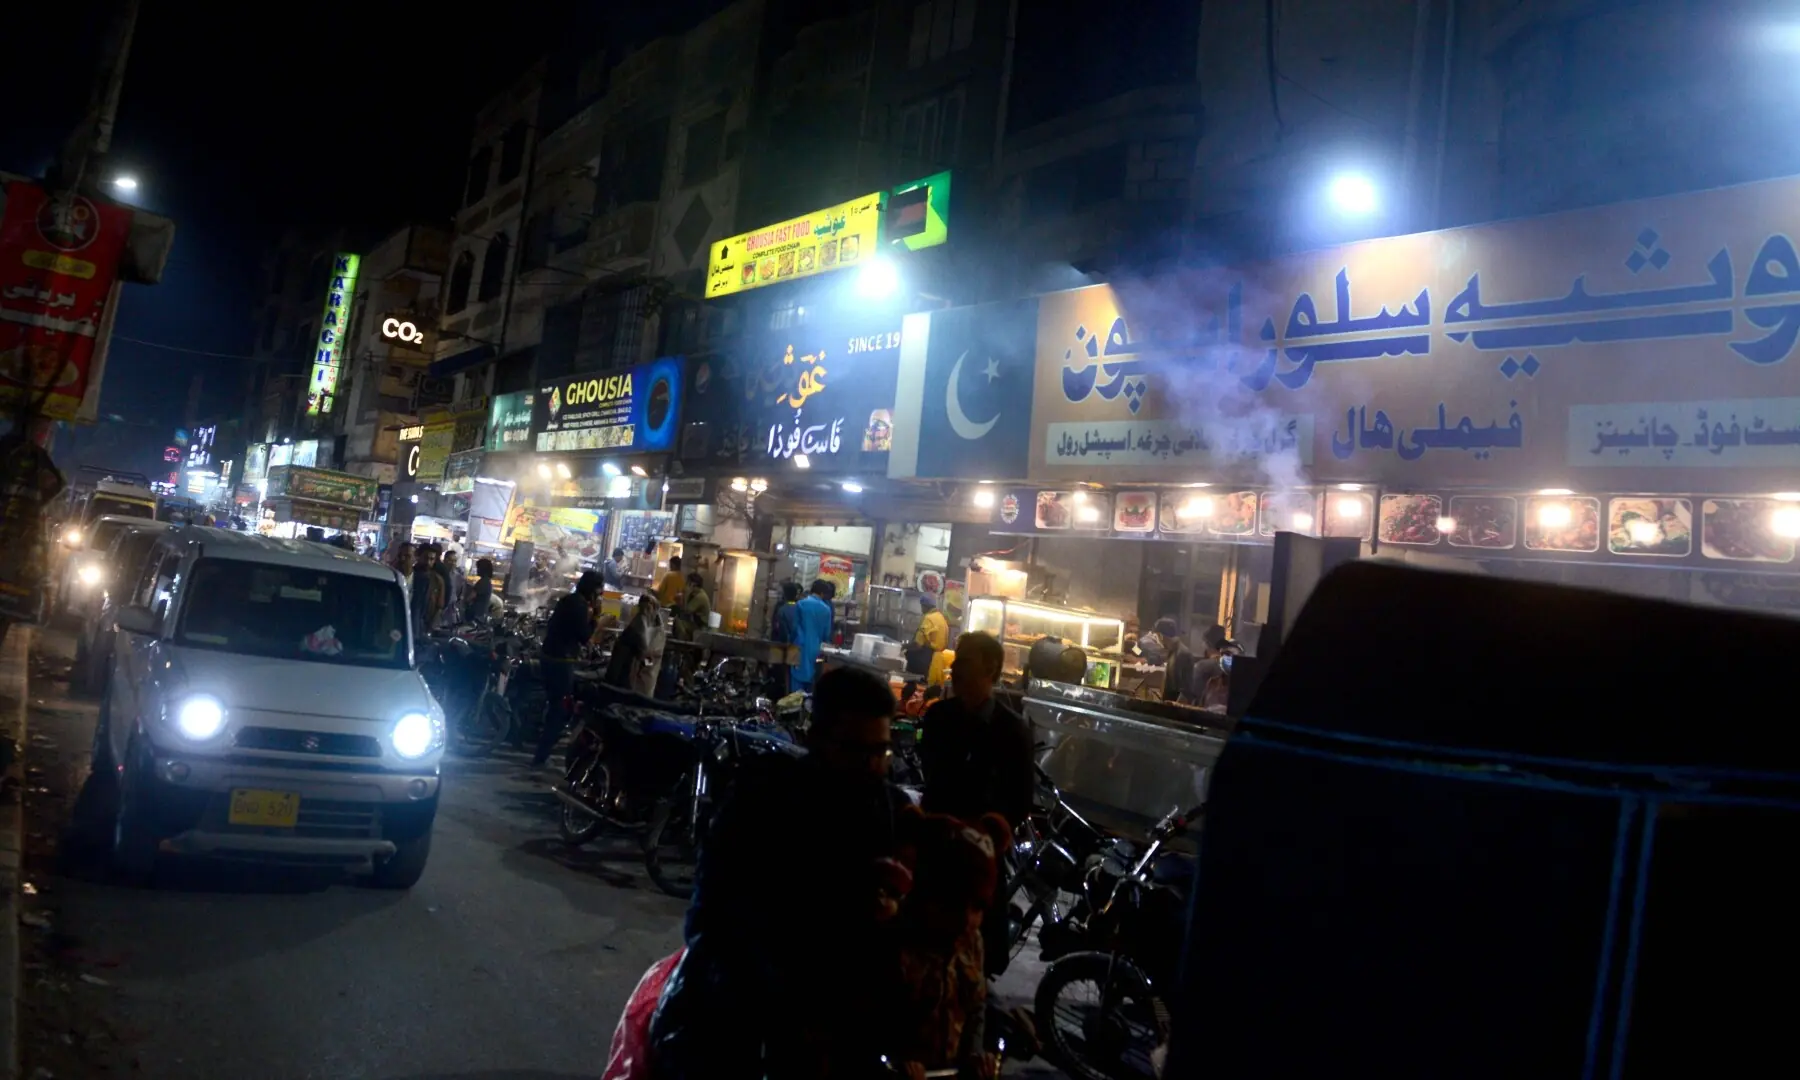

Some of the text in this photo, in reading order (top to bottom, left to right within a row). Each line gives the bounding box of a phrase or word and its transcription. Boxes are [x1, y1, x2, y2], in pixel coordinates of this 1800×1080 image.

[746, 220, 810, 252] GHOUSIA FAST FOOD
[317, 255, 349, 383] KARACHI
[1443, 227, 1800, 380] وثیہ
[847, 331, 901, 355] SINCE 19
[566, 373, 633, 406] GHOUSIA
[1398, 401, 1523, 460] فیملی
